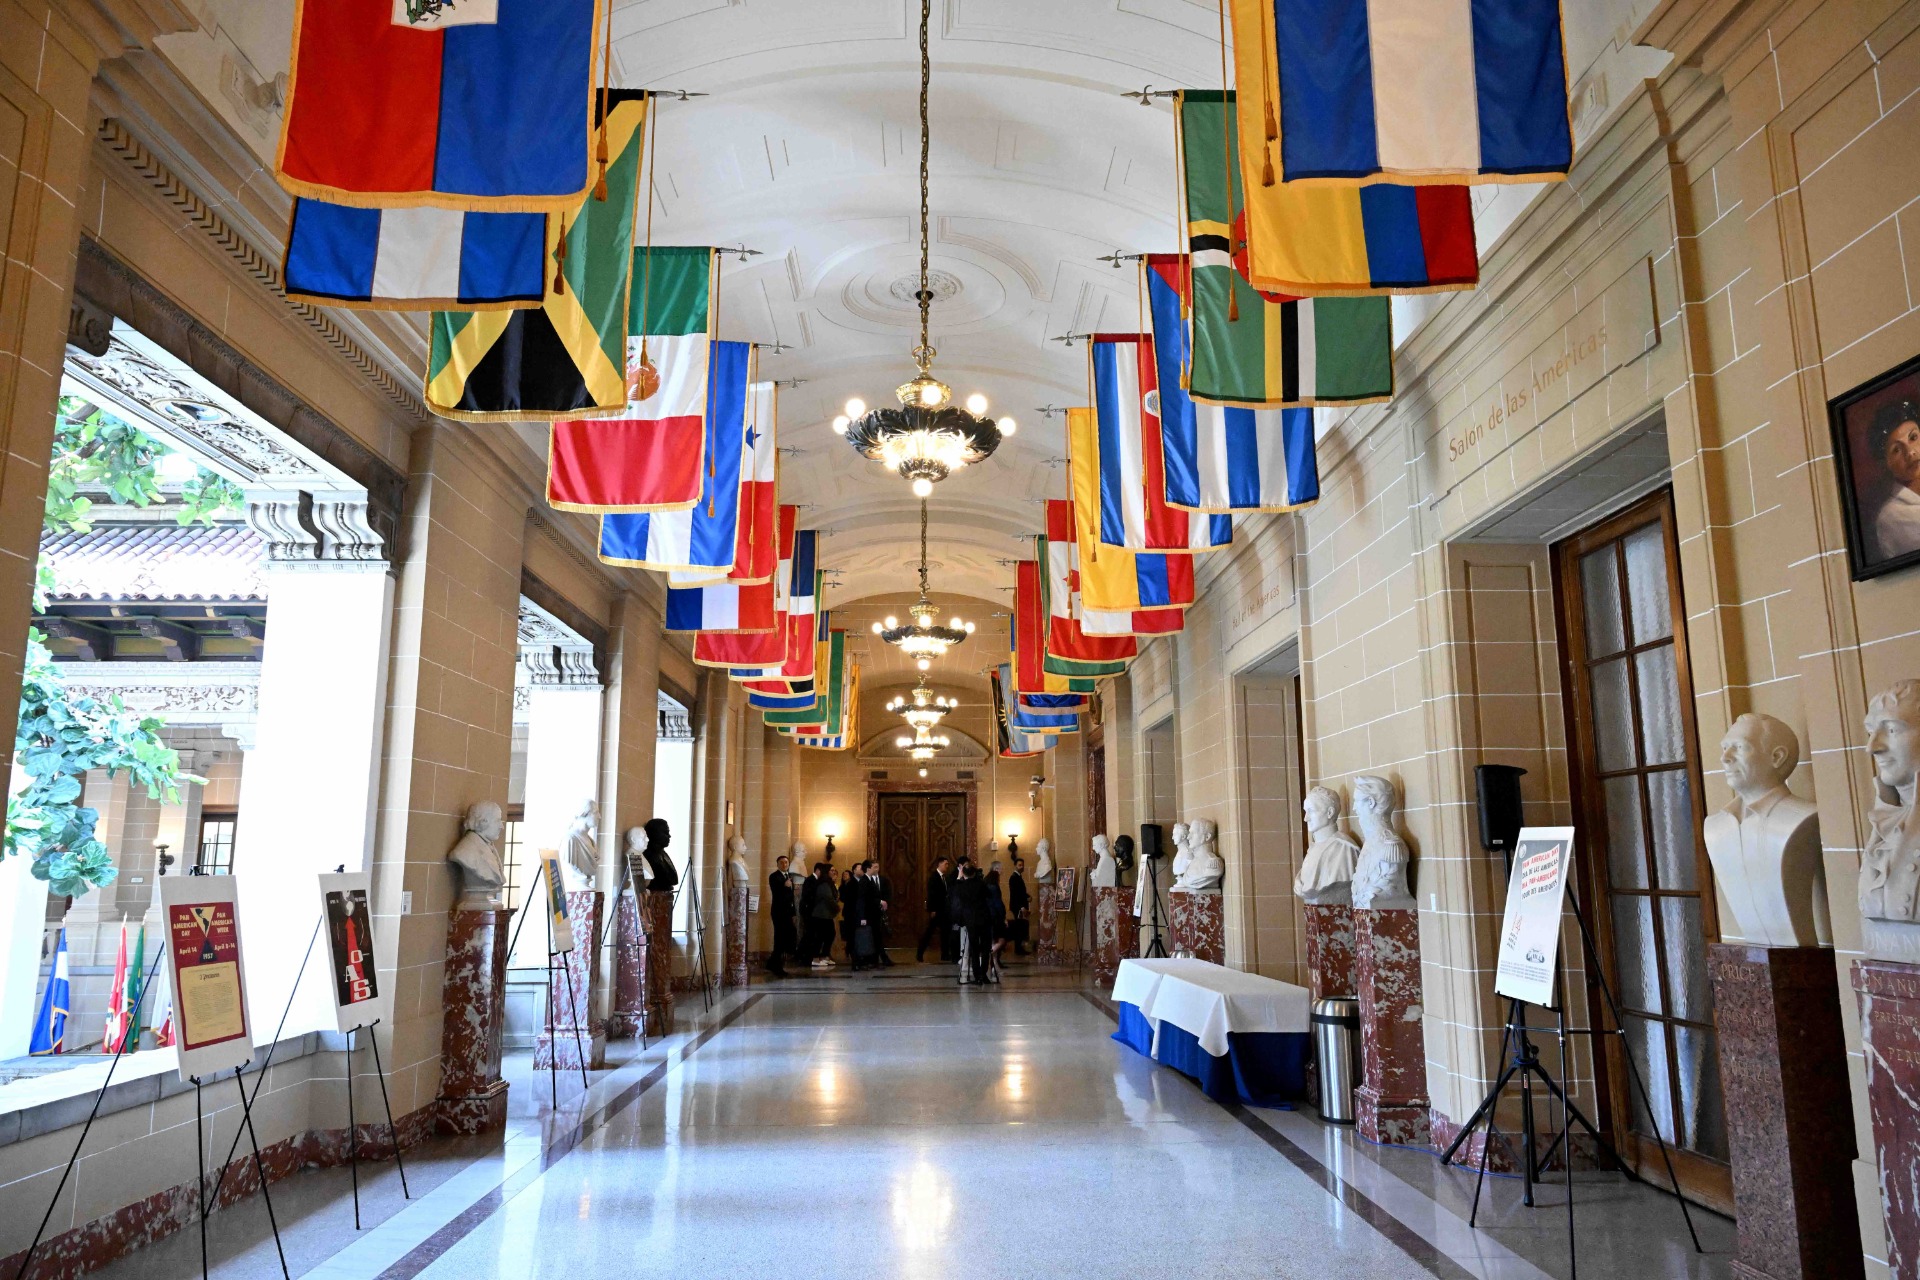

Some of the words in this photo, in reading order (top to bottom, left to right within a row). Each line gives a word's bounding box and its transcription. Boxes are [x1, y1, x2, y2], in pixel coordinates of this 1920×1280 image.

[1449, 423, 1484, 463] Salón
[1488, 404, 1504, 431] de
[1506, 393, 1528, 418] las
[179, 946, 191, 955] April
[1863, 931, 1920, 953] UNAN
[1721, 963, 1756, 983] PRICE
